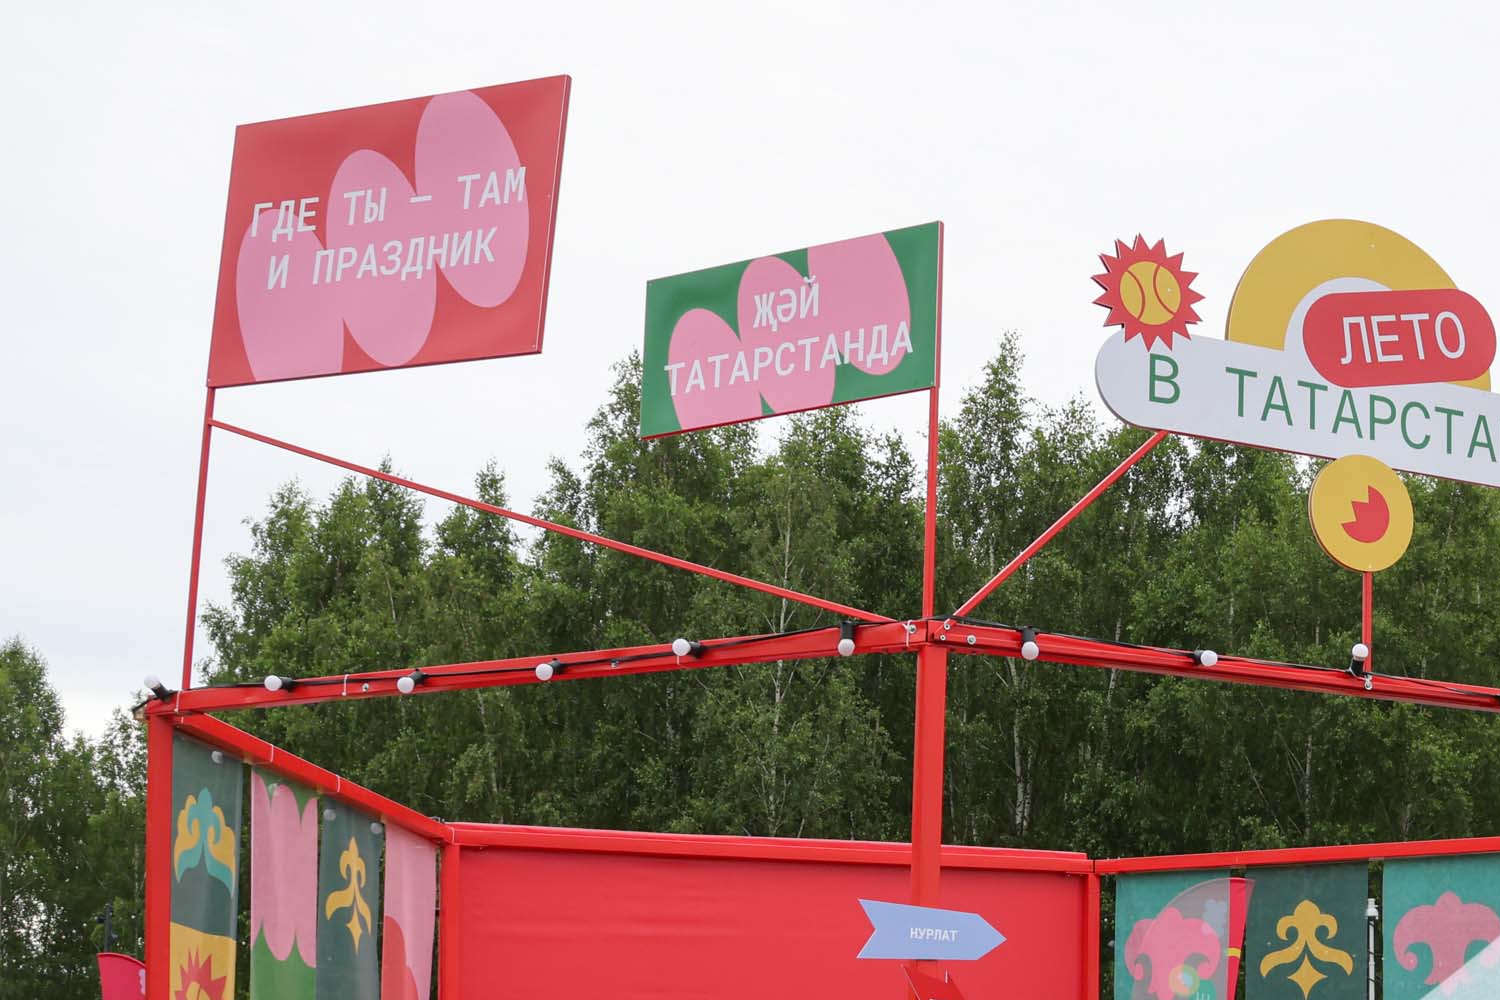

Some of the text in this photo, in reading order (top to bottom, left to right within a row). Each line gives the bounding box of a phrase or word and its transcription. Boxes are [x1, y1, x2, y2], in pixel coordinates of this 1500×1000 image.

[249, 197, 320, 240] ГДЕ
[342, 187, 388, 226] ТЫ
[456, 166, 528, 208] ТАМ
[266, 226, 498, 291] И ПРАЗДНИК
[663, 319, 914, 398] ТАТАРСТАНДА
[1340, 310, 1467, 366] ЛЕТО
[1148, 353, 1181, 405] В
[909, 927, 959, 942] НУРЛАТ
